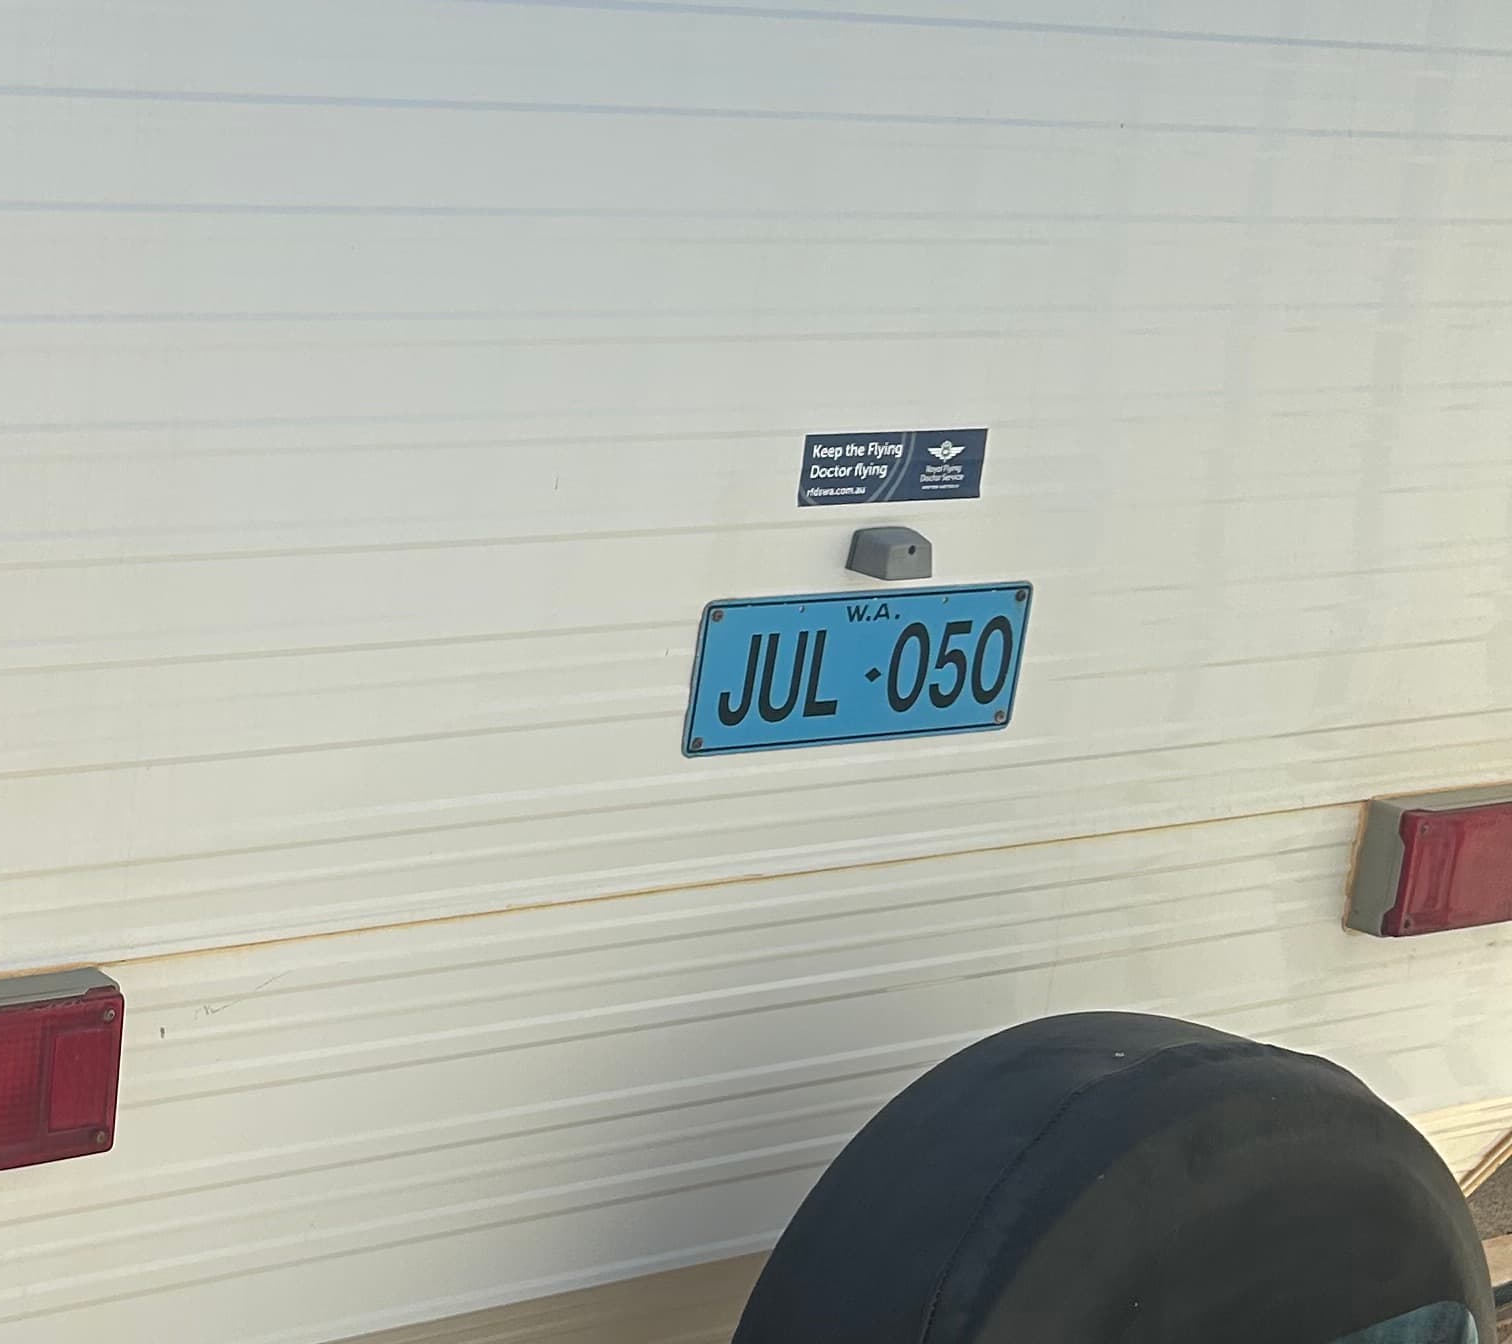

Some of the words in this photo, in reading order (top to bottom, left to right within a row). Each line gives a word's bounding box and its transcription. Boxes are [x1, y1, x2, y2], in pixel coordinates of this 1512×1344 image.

[812, 444, 843, 461] Keep
[845, 443, 865, 457] the
[867, 441, 904, 459] Flying
[810, 464, 853, 479] Doctor
[854, 462, 888, 480] flying
[846, 603, 901, 623] W.A.
[718, 629, 839, 727] JUL
[887, 614, 1014, 713] 050
